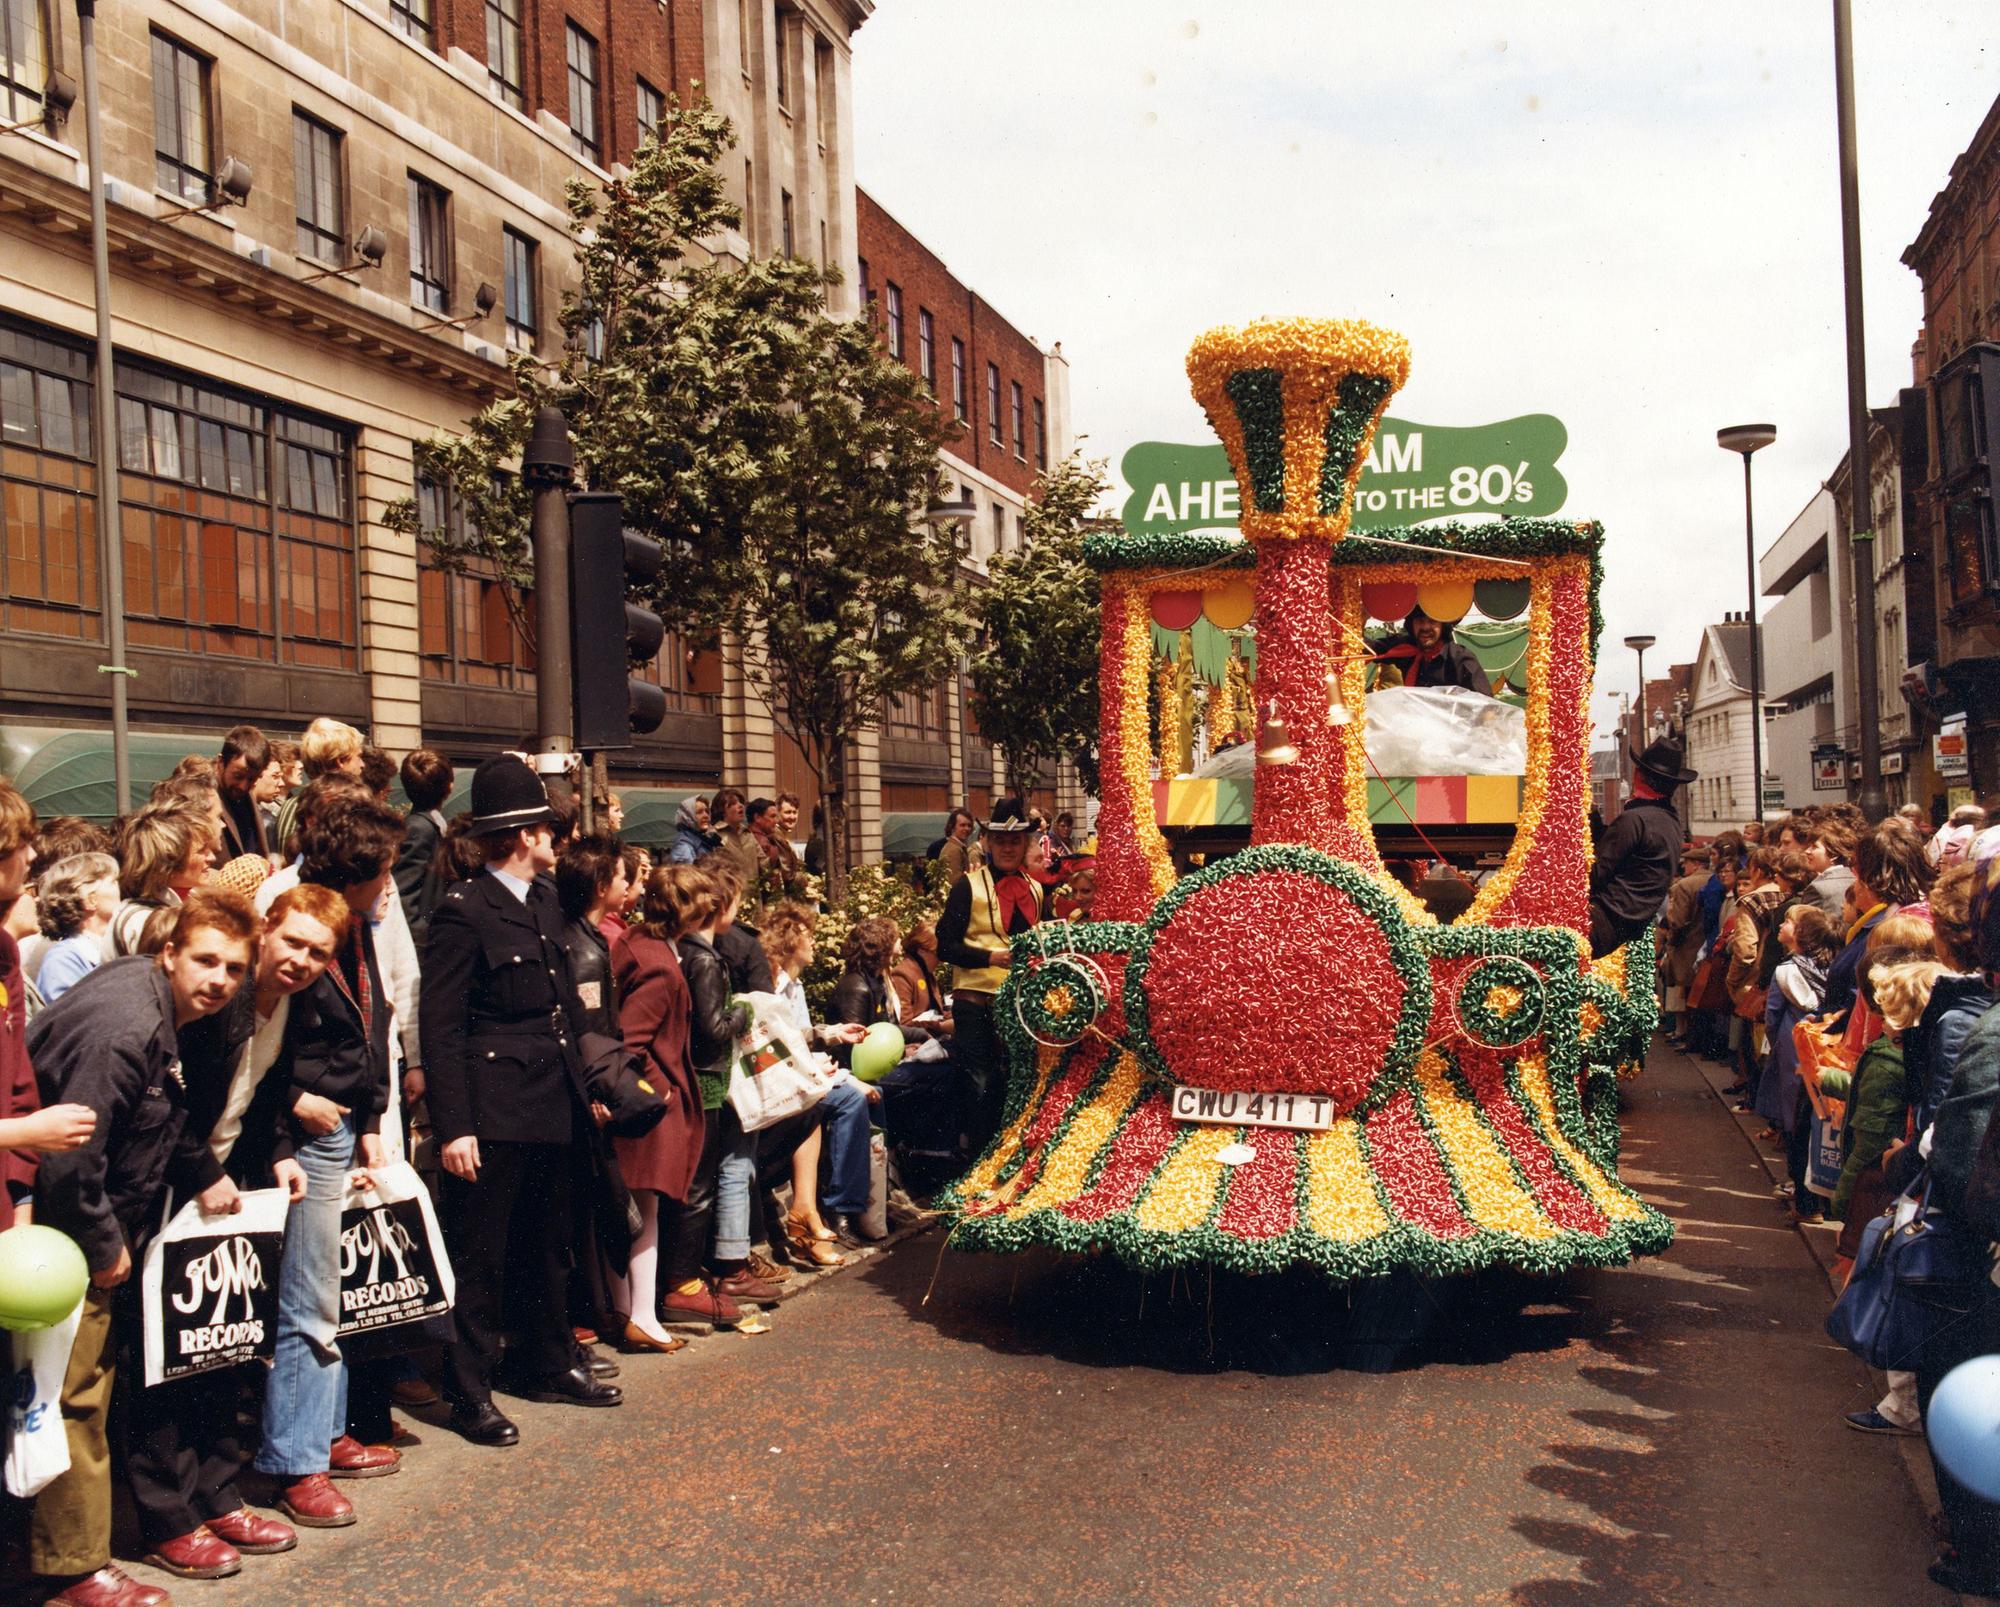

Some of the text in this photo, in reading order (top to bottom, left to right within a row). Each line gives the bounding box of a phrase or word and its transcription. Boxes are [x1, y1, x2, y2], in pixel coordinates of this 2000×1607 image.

[1391, 486, 1445, 510] THE
[1449, 460, 1534, 507] 80's
[1177, 1089, 1329, 1124] CWU 411 T
[1820, 1158, 1841, 1169] BUIL
[171, 1236, 267, 1325] JUMBO
[341, 1275, 430, 1312] RECORDS
[179, 1319, 265, 1355] RECORDS
